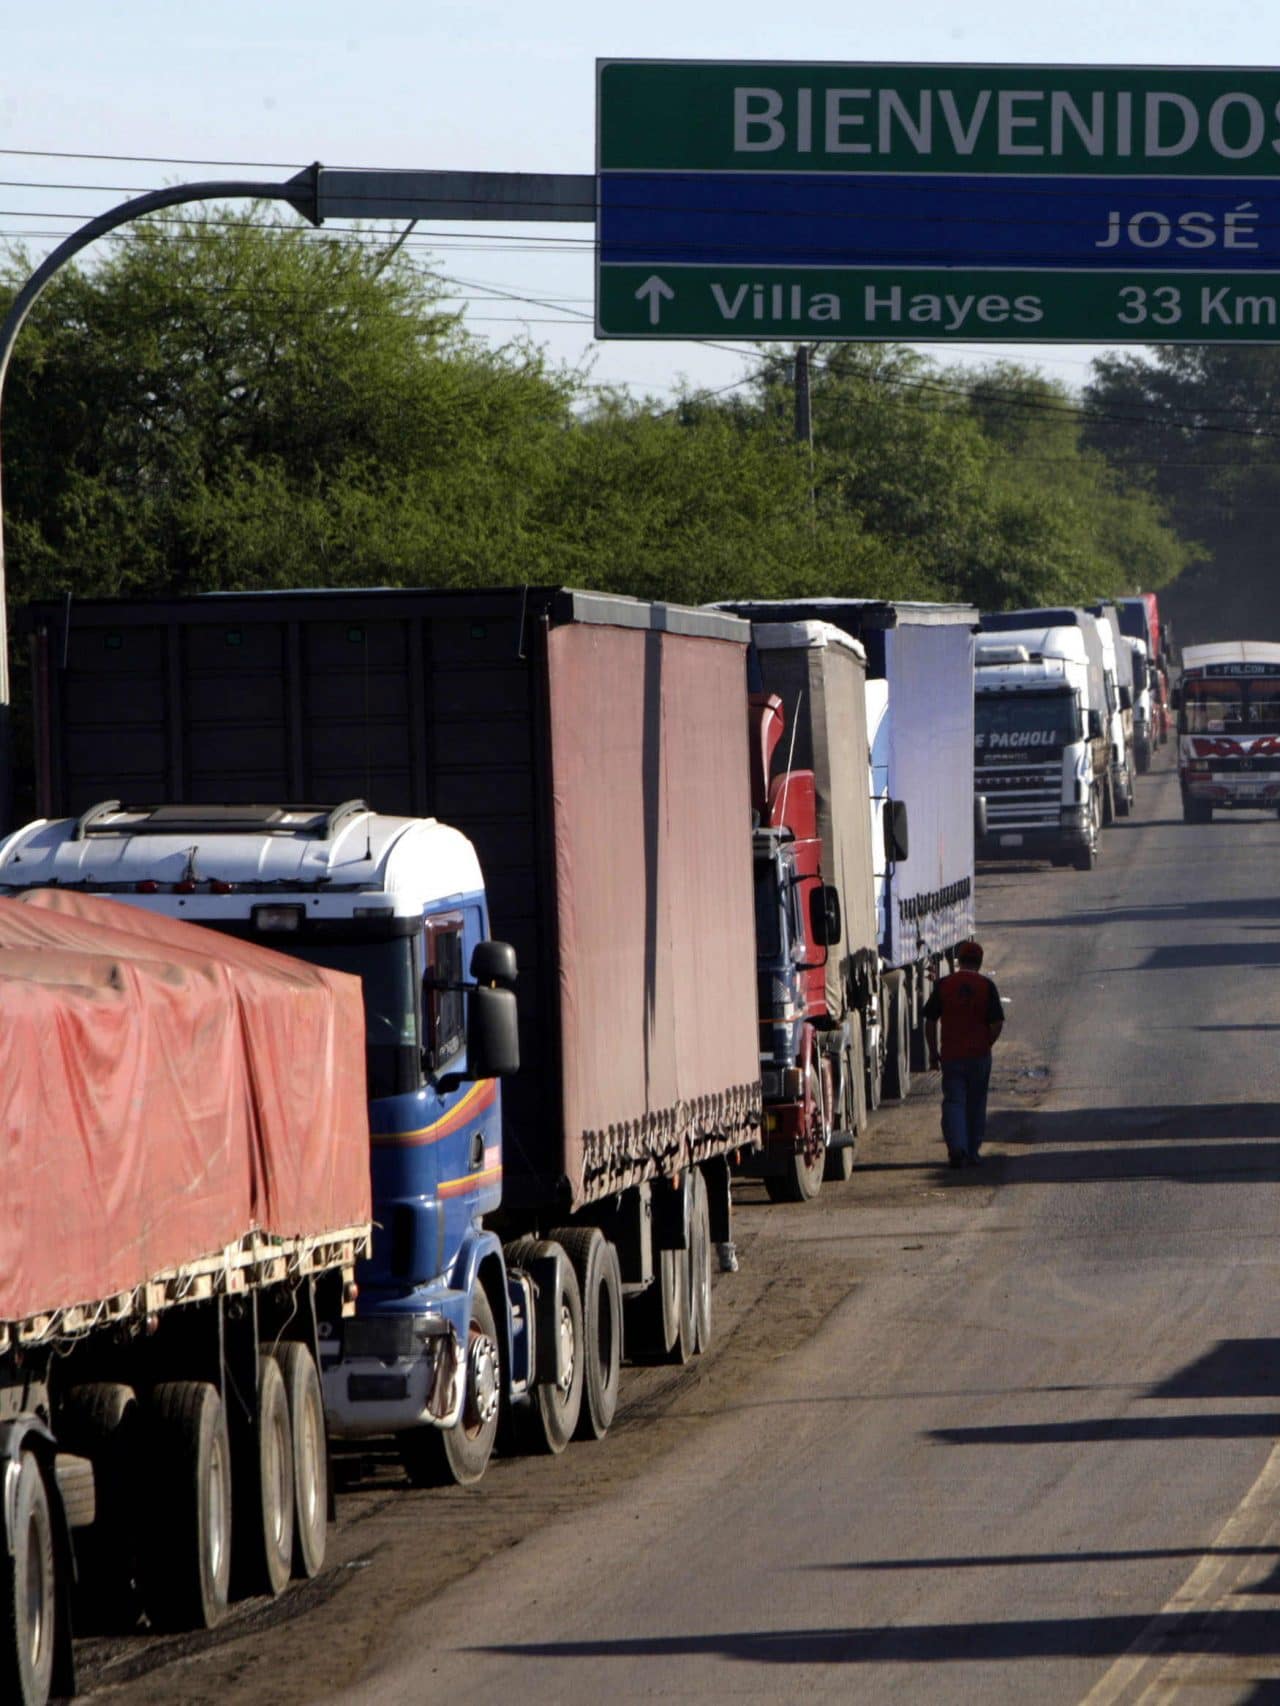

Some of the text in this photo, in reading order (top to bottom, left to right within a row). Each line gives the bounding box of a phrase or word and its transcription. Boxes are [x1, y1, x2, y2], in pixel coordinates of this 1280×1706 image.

[1096, 202, 1259, 249] JOSÉ
[711, 283, 1044, 332] Villa Hayes
[1116, 286, 1183, 325] 33
[989, 730, 1057, 748] PACHOLI
